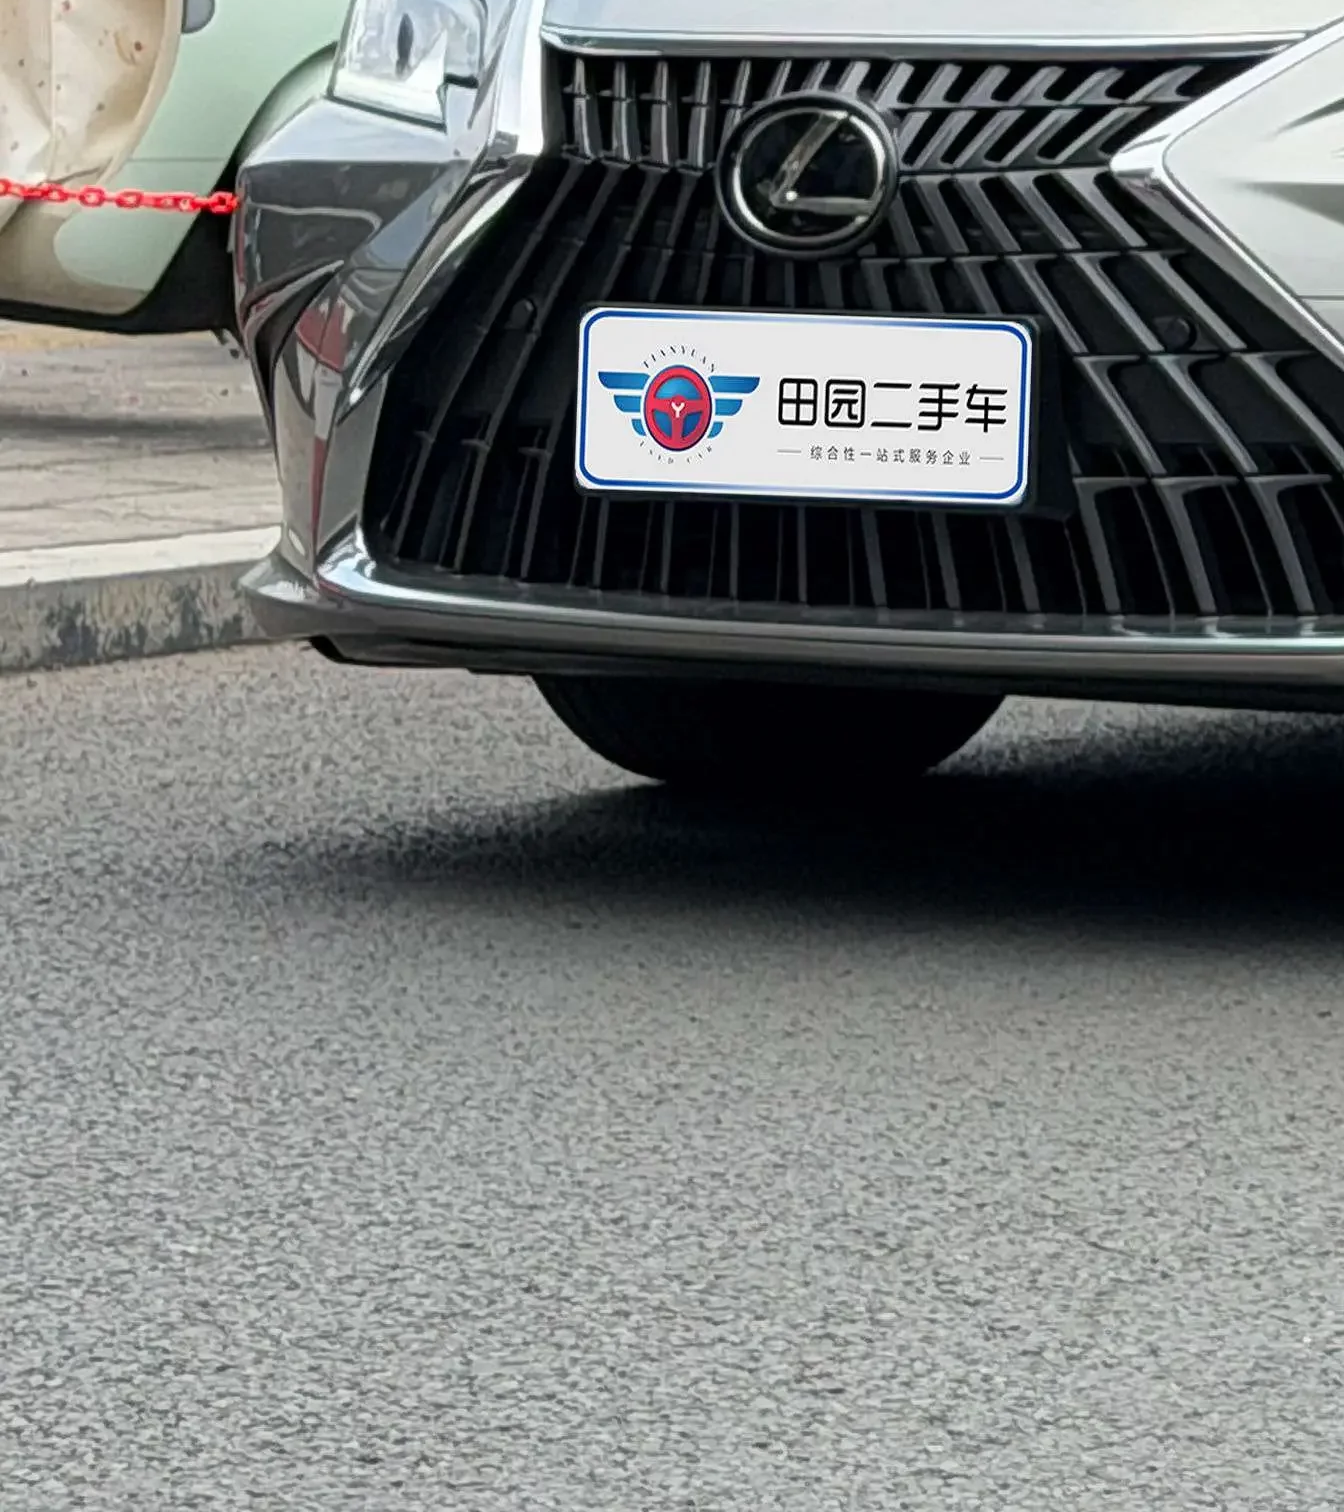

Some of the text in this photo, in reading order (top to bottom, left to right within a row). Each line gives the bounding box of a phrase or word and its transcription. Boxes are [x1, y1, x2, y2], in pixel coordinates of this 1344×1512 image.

[778, 378, 1007, 433] 田园二手车
[810, 445, 971, 465] 综合性一站式服务企业
